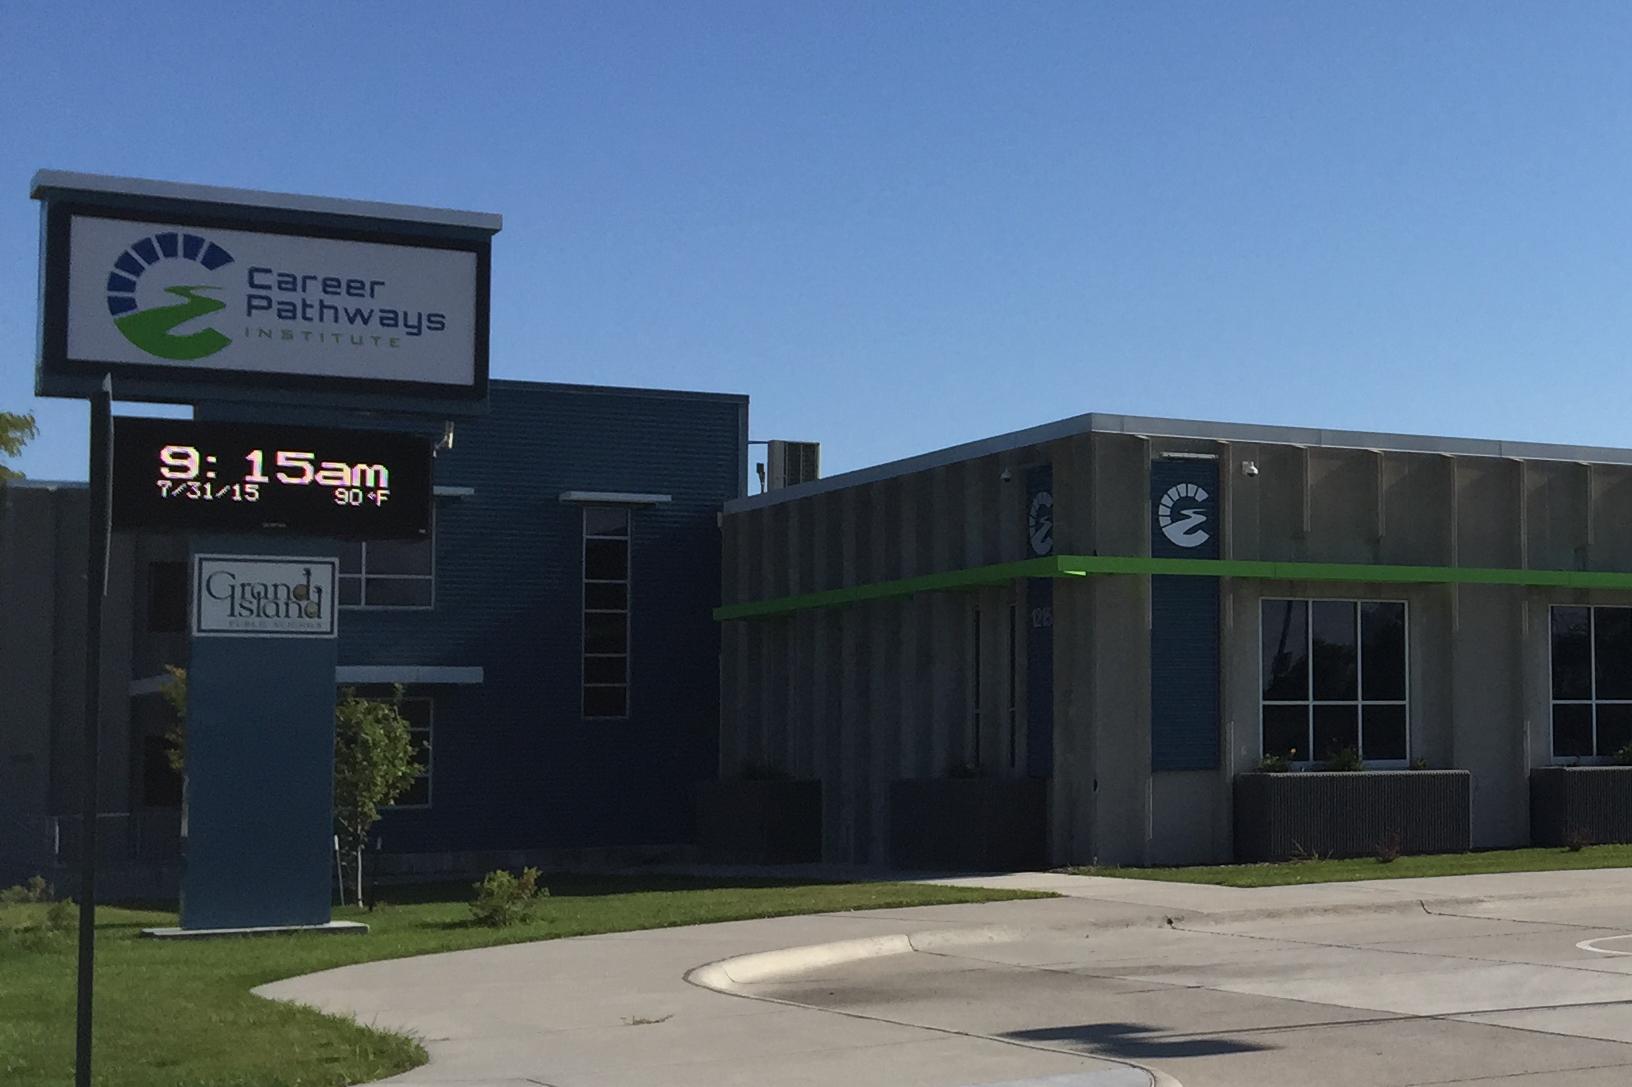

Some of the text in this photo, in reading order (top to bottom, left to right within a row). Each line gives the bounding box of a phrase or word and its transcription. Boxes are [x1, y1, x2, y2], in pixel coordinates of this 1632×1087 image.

[247, 266, 385, 299] Career
[246, 293, 446, 337] Pathways
[244, 327, 401, 348] INSTITUTE
[156, 480, 260, 502] 7/31/15
[206, 567, 311, 602] Grand
[227, 585, 322, 619] Island
